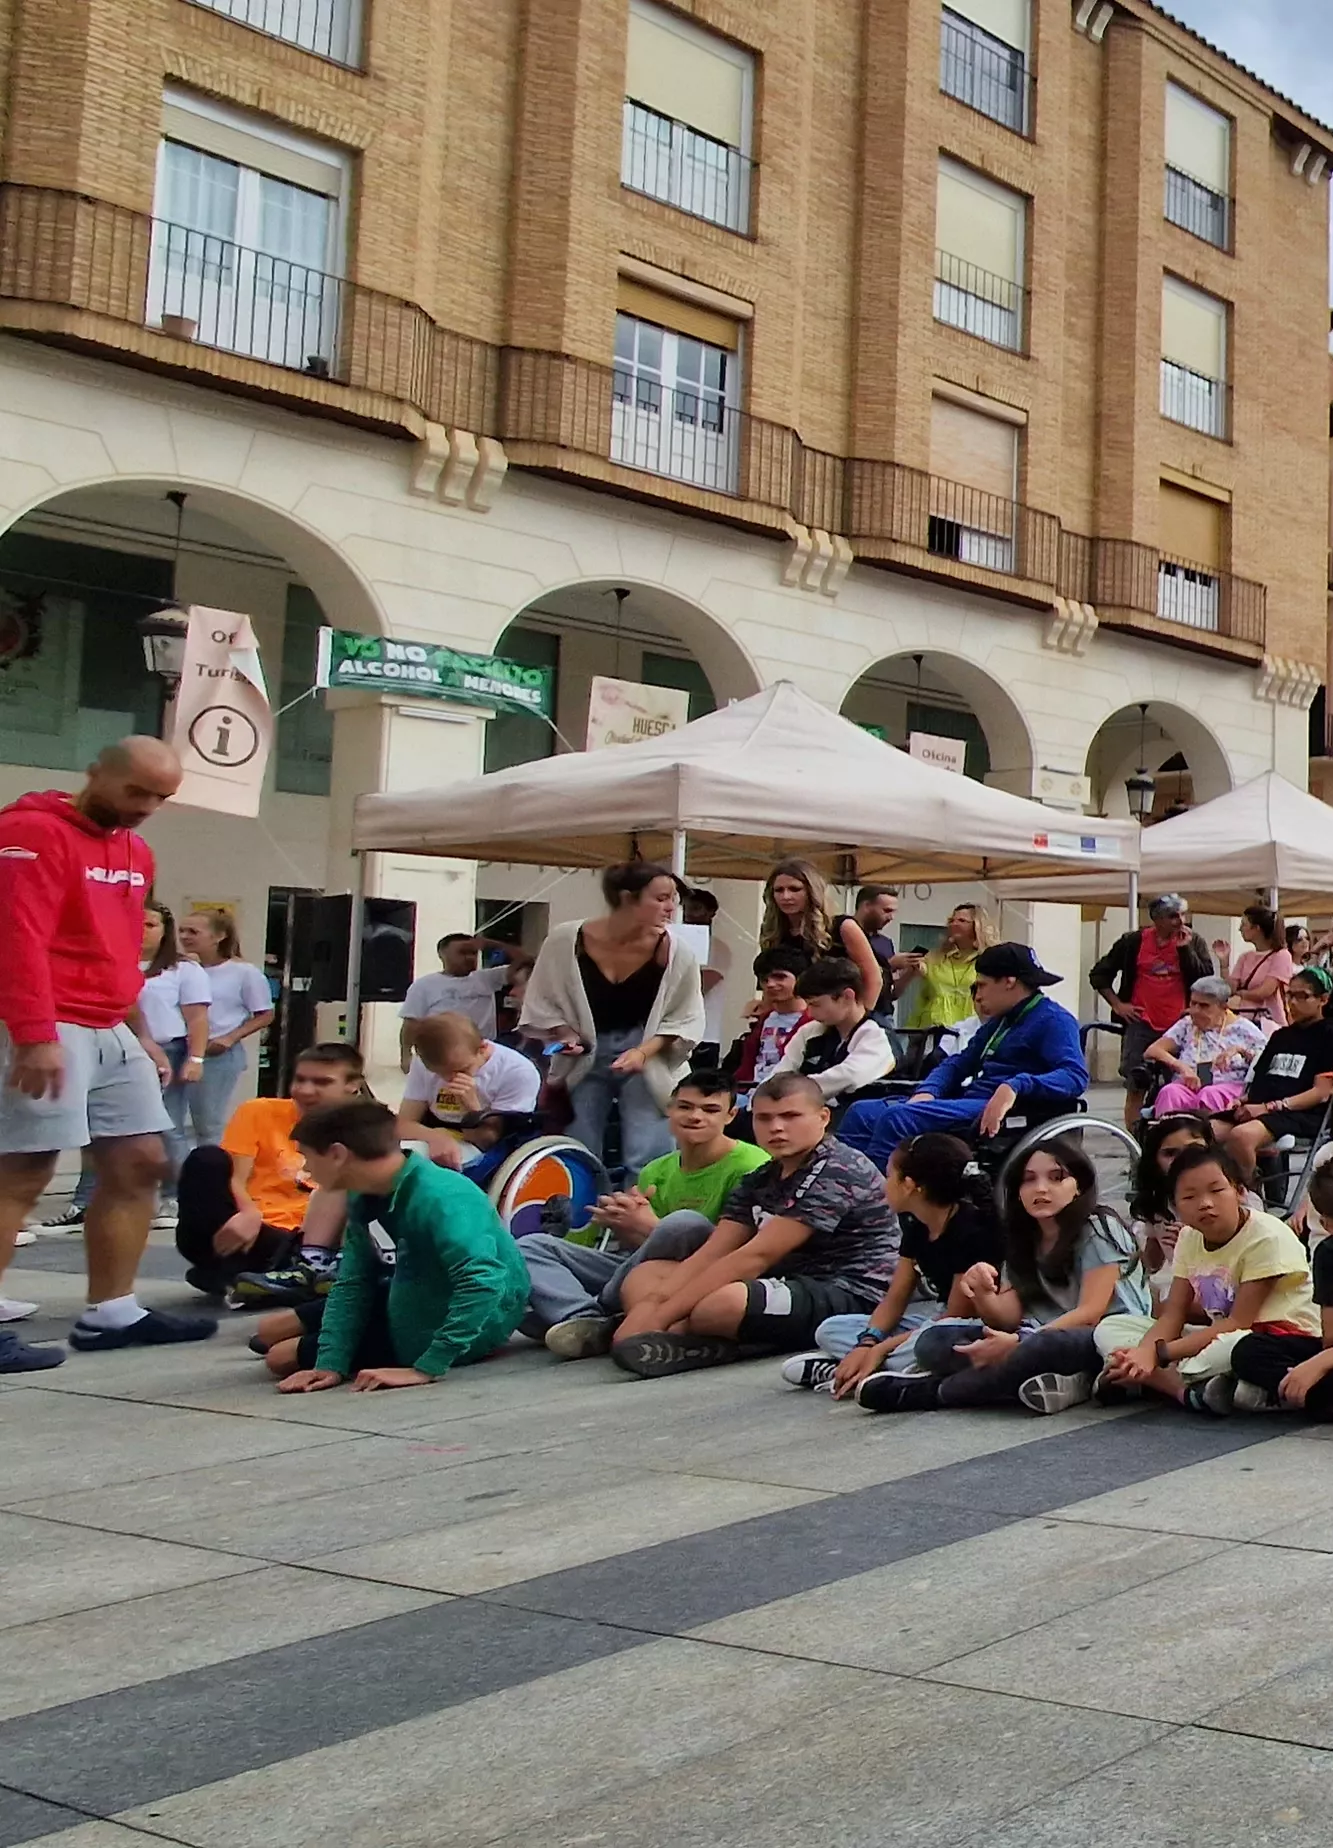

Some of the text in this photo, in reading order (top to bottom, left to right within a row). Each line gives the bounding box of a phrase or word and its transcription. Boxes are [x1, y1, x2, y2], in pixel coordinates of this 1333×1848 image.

[386, 641, 428, 663] NO
[338, 659, 443, 684] ALCOHOL
[463, 674, 542, 703] MENORES
[632, 716, 676, 737] HUESC
[921, 749, 958, 764] Oficina
